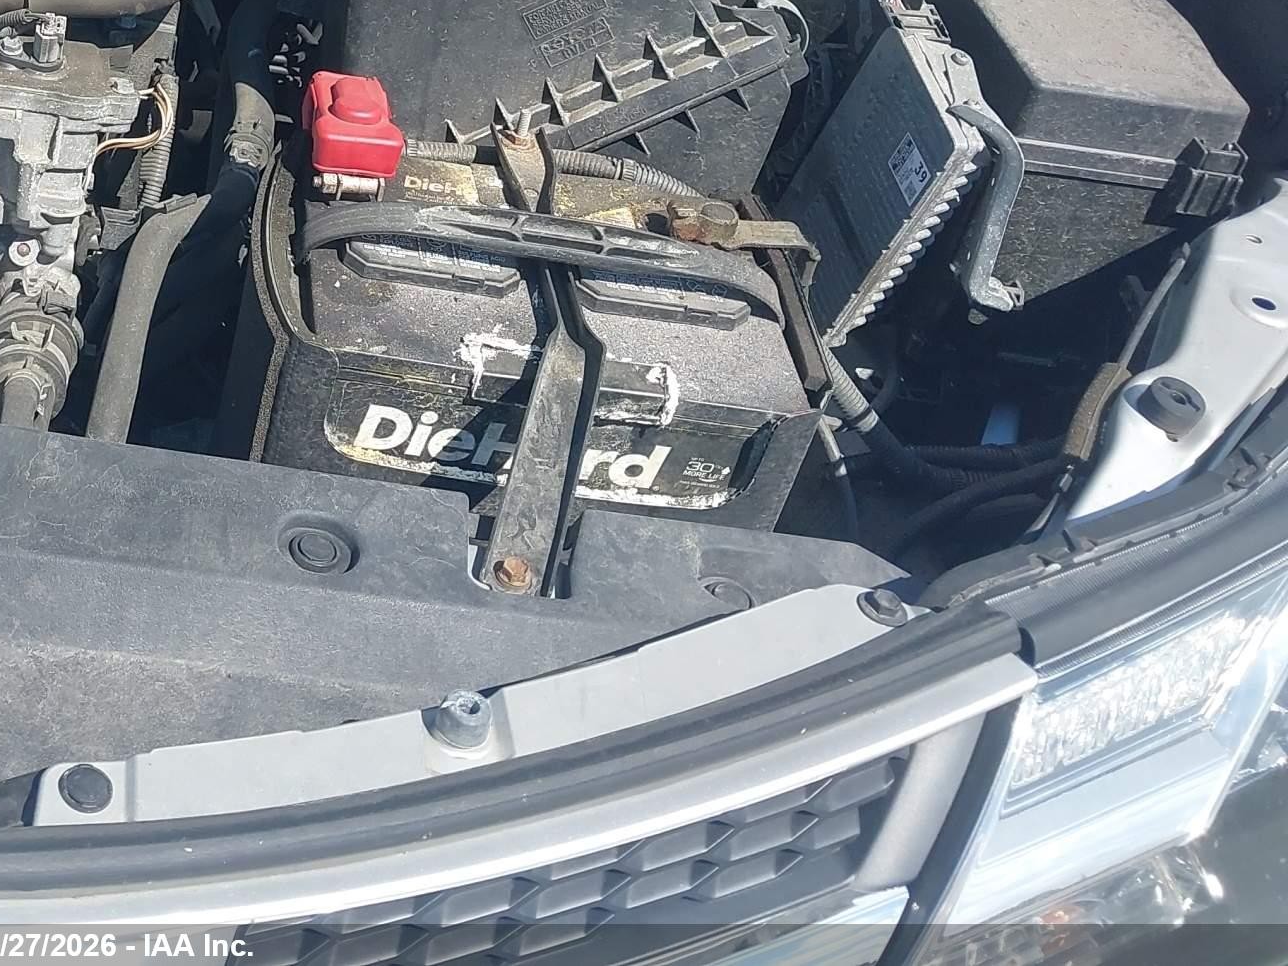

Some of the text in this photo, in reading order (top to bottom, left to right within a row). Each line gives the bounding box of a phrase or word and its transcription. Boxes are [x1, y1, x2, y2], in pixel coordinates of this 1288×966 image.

[915, 161, 928, 183] 39
[353, 403, 672, 489] DieHrd
[682, 470, 726, 481] MORE LIFE
[686, 461, 715, 473] 30
